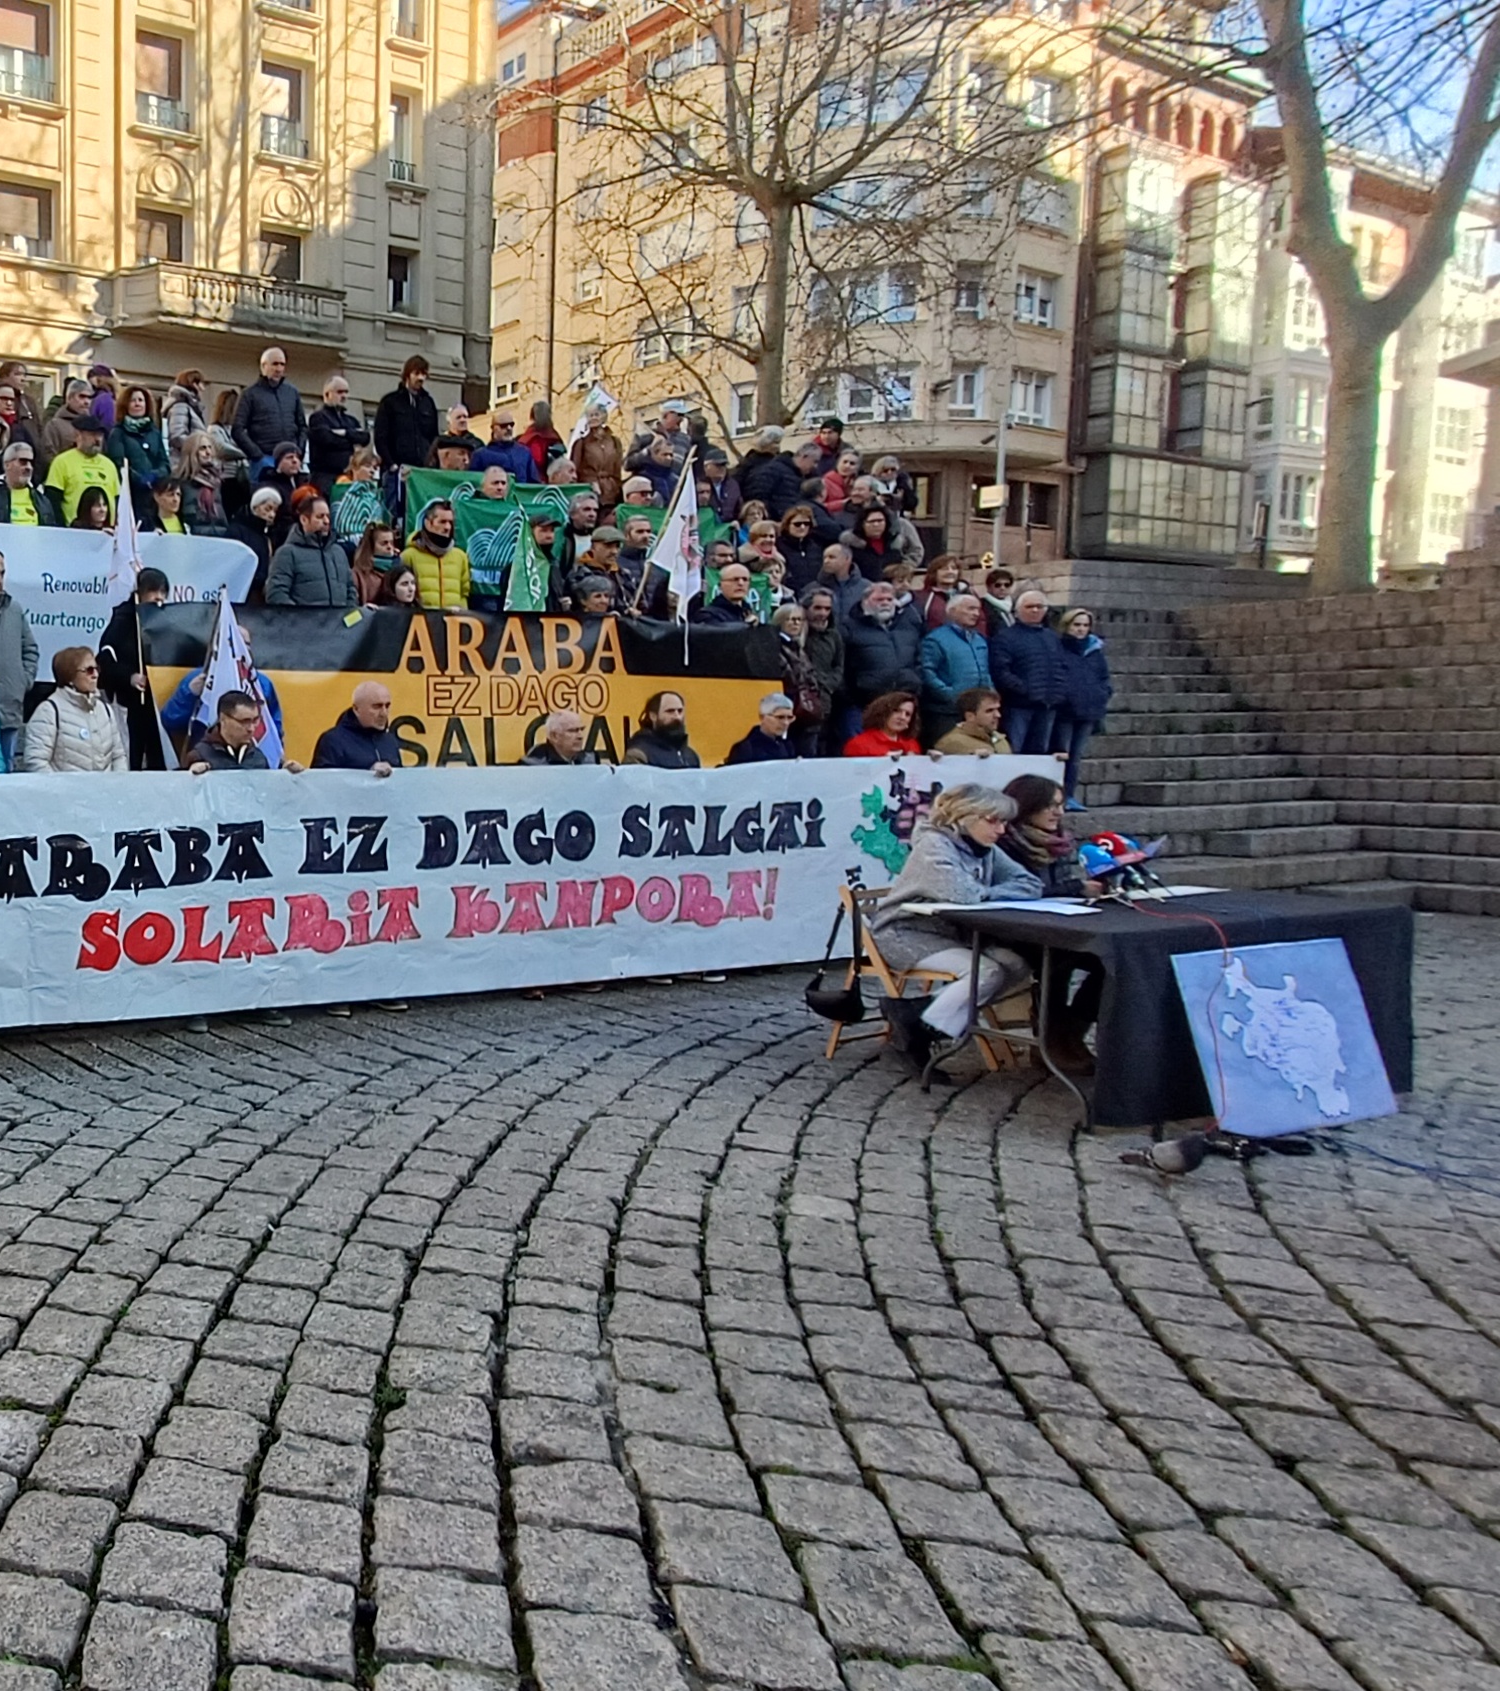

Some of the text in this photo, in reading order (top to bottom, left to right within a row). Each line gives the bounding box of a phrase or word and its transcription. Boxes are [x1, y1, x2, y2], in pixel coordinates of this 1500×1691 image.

[41, 572, 109, 594] Renovabl
[22, 608, 106, 634] uartango
[399, 614, 627, 676] ARABA
[426, 673, 609, 716] EZ DAGO
[298, 817, 388, 873] EZ
[417, 808, 596, 869] DAGO
[446, 867, 780, 937] KANPORA!
